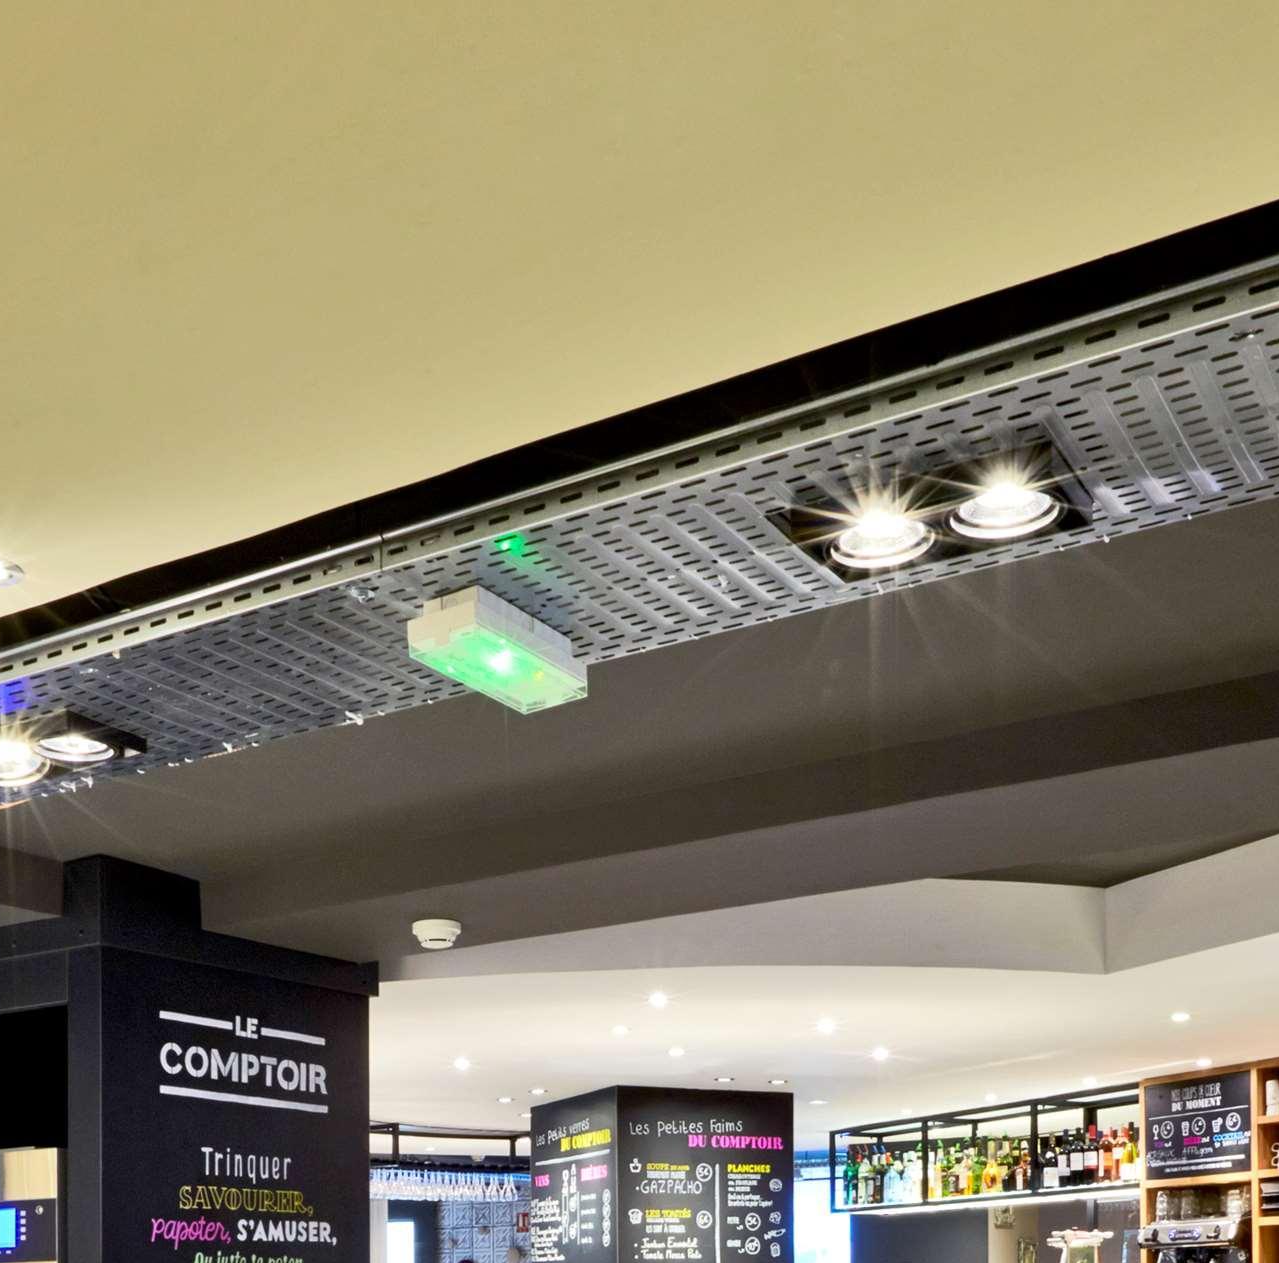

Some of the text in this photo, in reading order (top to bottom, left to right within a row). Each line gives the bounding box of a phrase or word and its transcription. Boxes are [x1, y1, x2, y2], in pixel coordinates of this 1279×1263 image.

[234, 1014, 260, 1040] LE
[159, 1041, 328, 1095] COMPTOIR
[1171, 1096, 1222, 1112] DU MOMENT
[572, 1128, 612, 1149] COMPTOIR
[629, 1121, 650, 1136] Les
[688, 1135, 784, 1150] DU COMPTOIR
[200, 1147, 292, 1183] Trinquer
[727, 1163, 771, 1173] PLANCHES
[640, 1179, 703, 1194] GAZPACHO
[179, 1185, 314, 1217] SAVOURER,
[237, 1218, 337, 1246] S'AMUSER,
